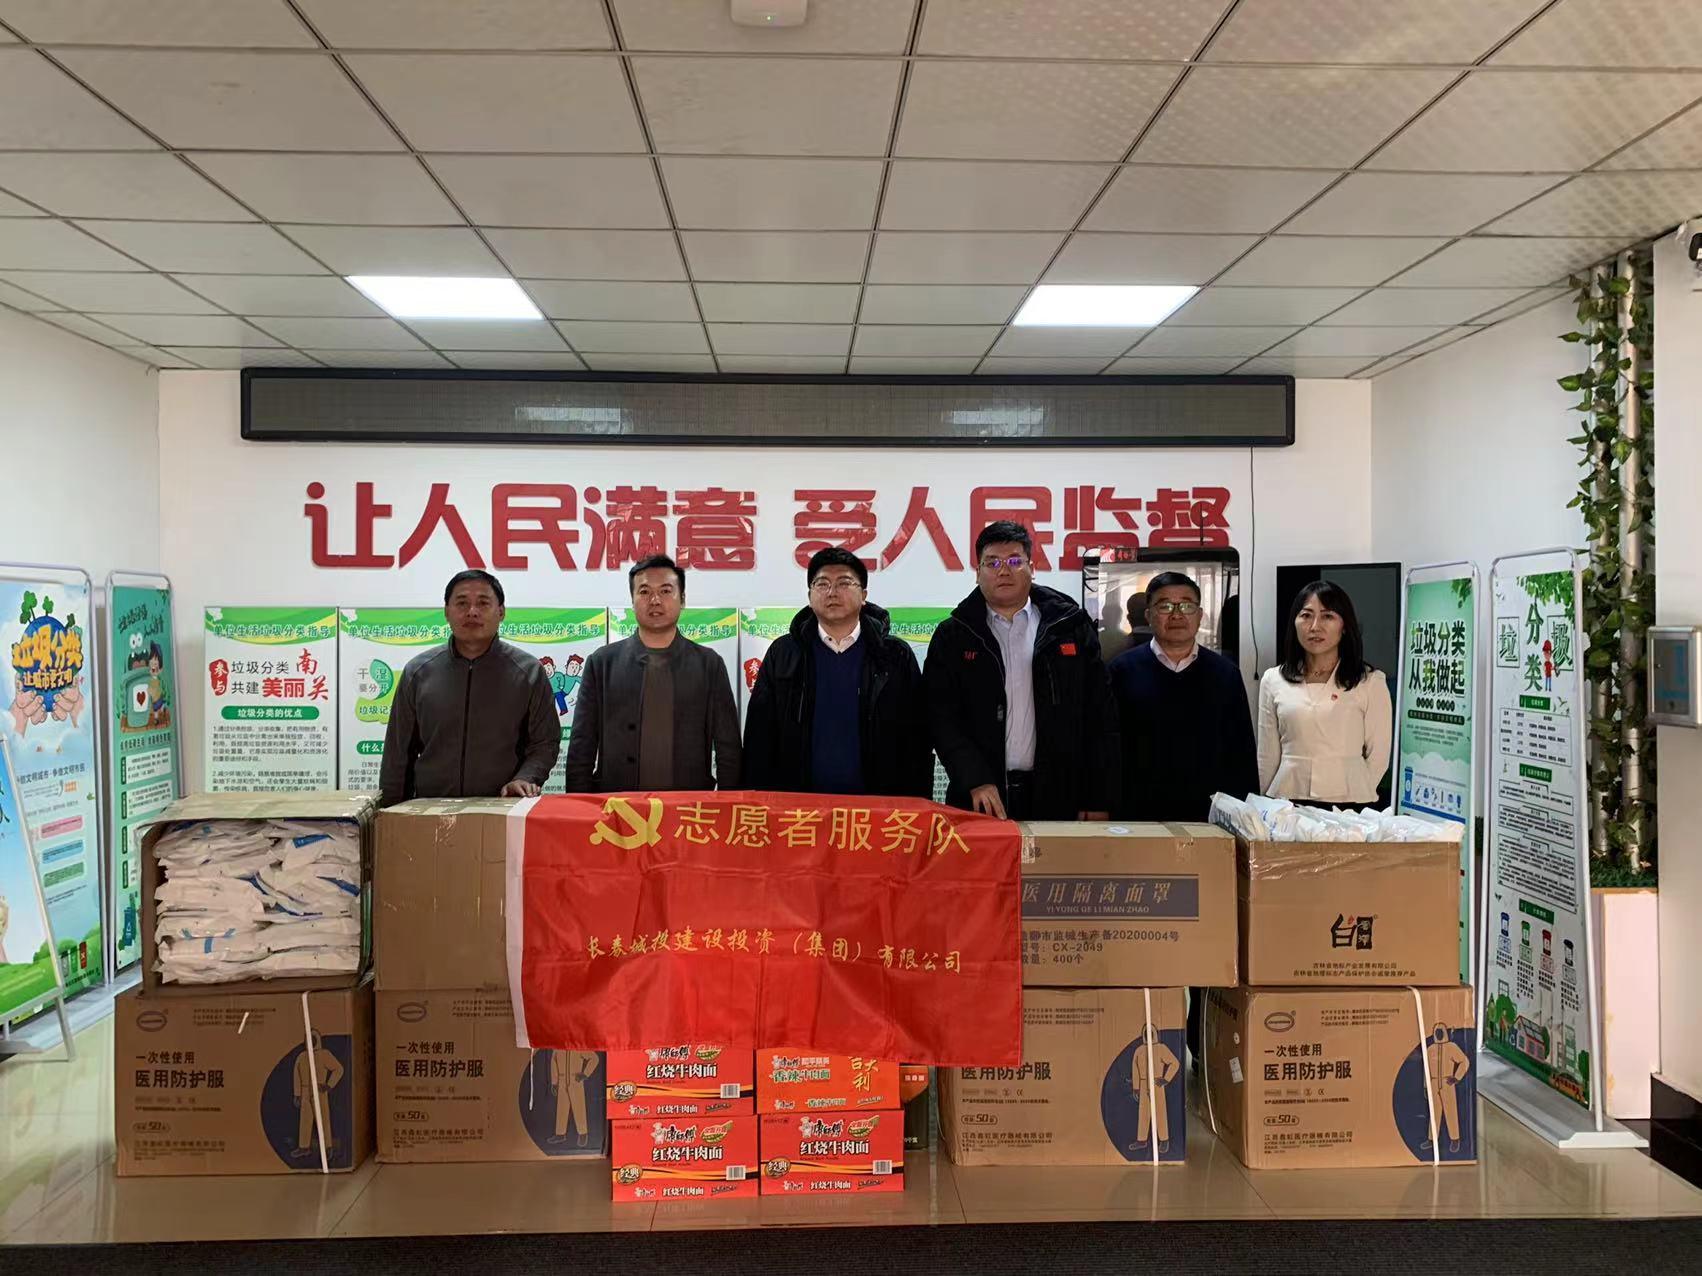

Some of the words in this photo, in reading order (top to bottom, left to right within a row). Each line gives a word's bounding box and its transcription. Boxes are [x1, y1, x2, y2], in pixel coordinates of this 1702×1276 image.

[304, 481, 757, 571] 让人民满意
[794, 485, 1232, 571] 受人民监督
[214, 624, 331, 638] 单位生活垃圾分类指导
[1410, 620, 1465, 655] 垃圾分类
[12, 623, 83, 670] 垃圾分类
[231, 661, 289, 675] 垃圾分类
[214, 662, 227, 693] 参与
[1408, 658, 1465, 695] 从我做起
[237, 708, 303, 718] 垃圾分类的优点
[359, 705, 391, 715] 垃圾记
[674, 800, 971, 856] 志愿者服务队
[1022, 882, 1171, 904] 医用隔离面罩
[1052, 942, 1103, 952] CX-2049
[1053, 954, 1083, 964] 400个
[396, 1041, 455, 1055] 一次性使用
[1264, 1044, 1322, 1057] 一次性使用
[136, 1051, 195, 1065] 一次性使用
[395, 1059, 484, 1077] 医用防护服
[646, 1063, 717, 1079] 红烧牛肉面
[961, 1061, 1051, 1081] 医用防护服
[1264, 1061, 1352, 1081] 医用防护服
[135, 1069, 225, 1089] 医用防护服
[614, 1084, 634, 1096] 经典
[656, 1105, 698, 1113] 红烧牛肉面
[652, 1145, 723, 1161] 红烧牛肉面
[800, 1140, 870, 1156] 红烧牛肉面
[619, 1167, 640, 1178] 经典
[767, 1162, 788, 1172] 经典
[662, 1186, 704, 1196] 红烧牛肉面
[810, 1180, 851, 1190] 红烧牛肉面
